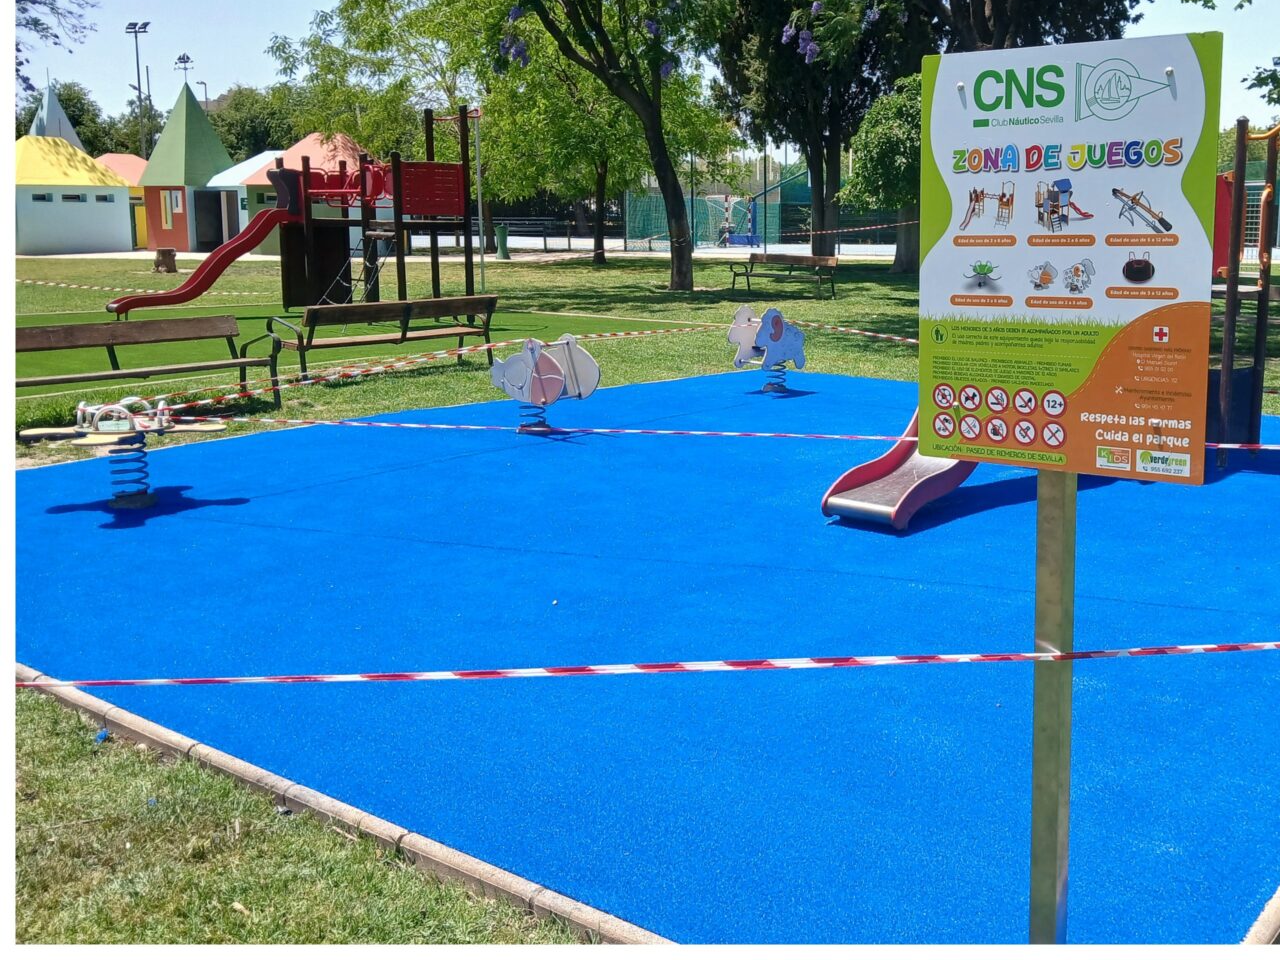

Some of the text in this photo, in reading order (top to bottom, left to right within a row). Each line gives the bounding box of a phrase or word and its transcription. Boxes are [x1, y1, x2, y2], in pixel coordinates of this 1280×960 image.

[974, 64, 1065, 112] CNS
[952, 137, 1183, 173] ZONA DE JUEGOS
[1046, 400, 1064, 409] 12+
[1080, 412, 1126, 424] Respeta
[1129, 416, 1145, 426] las
[1095, 429, 1190, 447] Cuida el parque
[966, 446, 985, 454] PASEO
[987, 448, 995, 456] DE
[996, 449, 1026, 459] REMEROS
[1028, 452, 1036, 460] DE
[1038, 452, 1063, 462] SEVILLA
